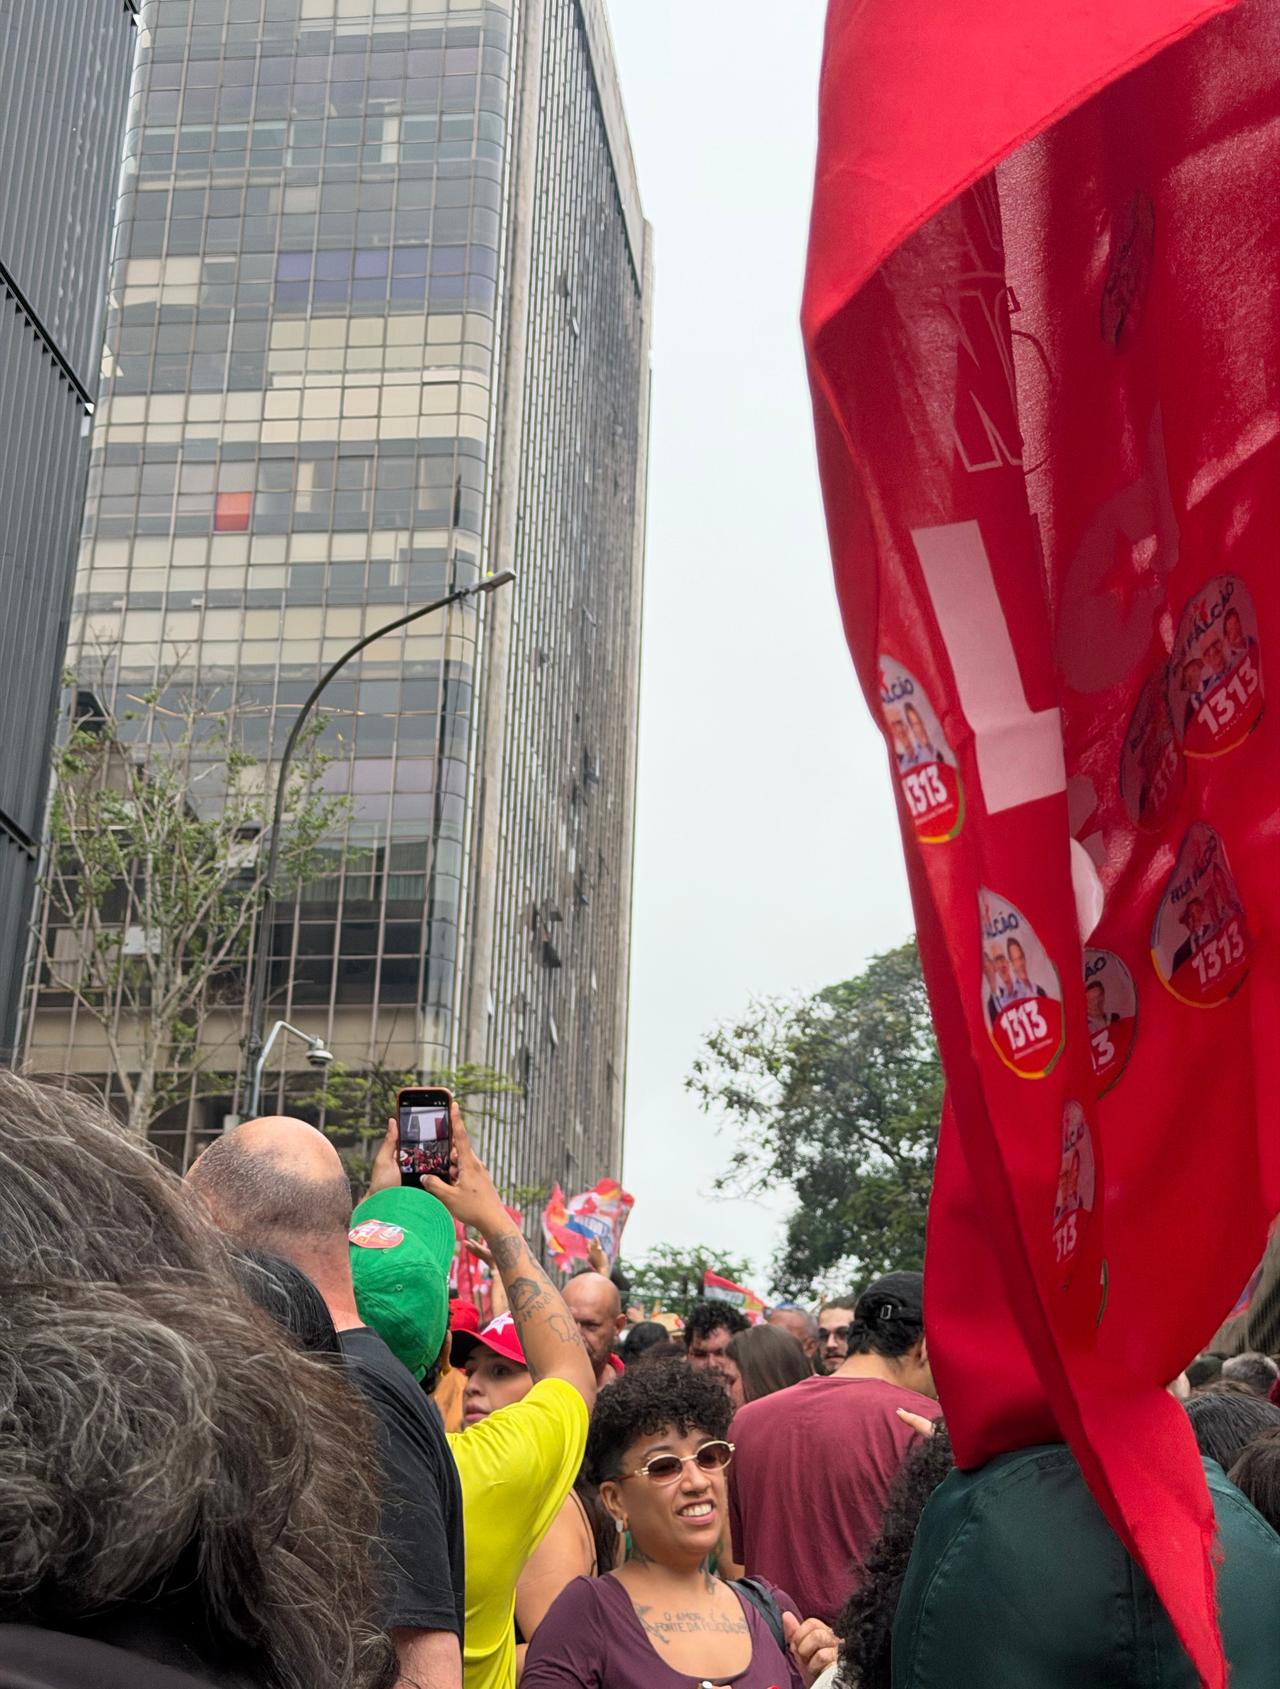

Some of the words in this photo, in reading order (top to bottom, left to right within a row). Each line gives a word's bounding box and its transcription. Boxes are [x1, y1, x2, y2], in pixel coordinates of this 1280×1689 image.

[1198, 656, 1259, 735] 1313
[1192, 921, 1244, 984] 1313
[1001, 999, 1048, 1050] 1313
